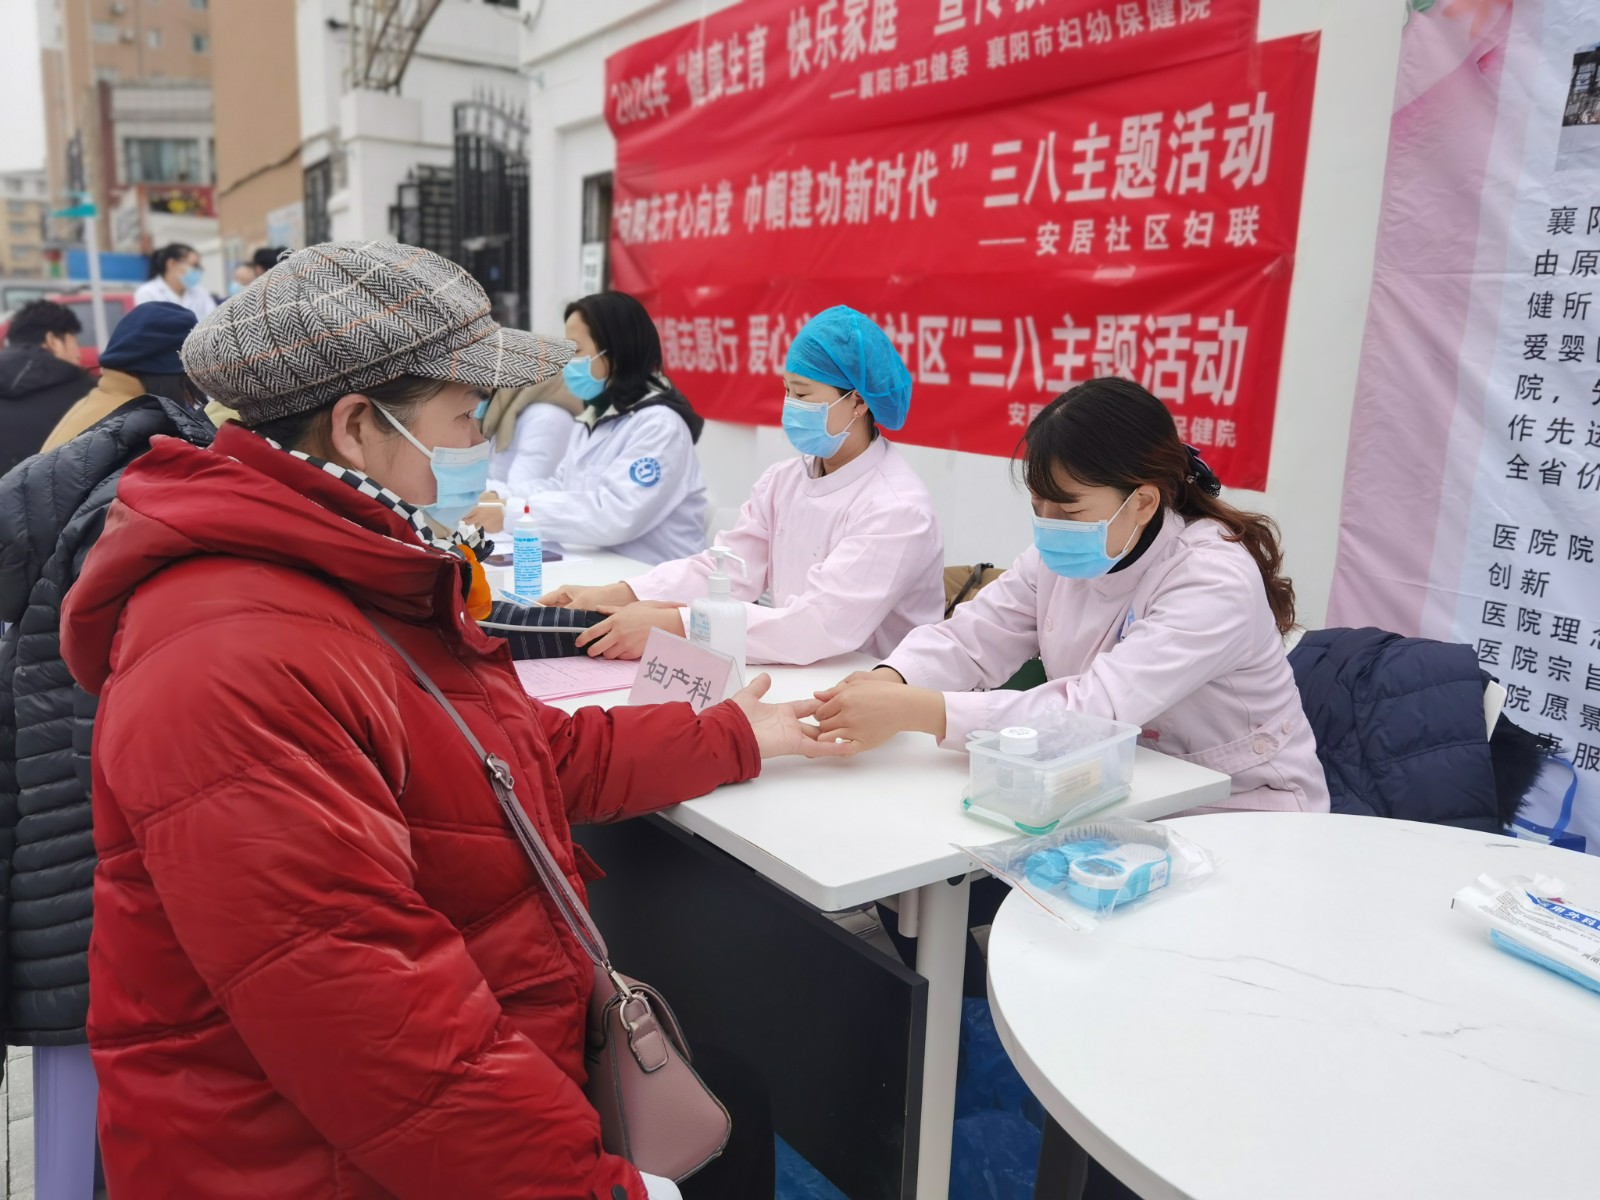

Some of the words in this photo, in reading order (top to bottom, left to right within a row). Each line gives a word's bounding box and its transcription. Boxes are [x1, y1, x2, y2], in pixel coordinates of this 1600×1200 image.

[787, 0, 898, 79] 快乐家庭
[986, 0, 1212, 70] 襄阳市妇幼保健院
[983, 91, 1276, 208] 三八主题活动
[1533, 249, 1600, 278] 由原
[1526, 291, 1592, 320] 健所
[1522, 334, 1600, 363] 爱婴
[1505, 453, 1600, 492] 全省价
[1492, 523, 1595, 564] 医院院
[1488, 562, 1551, 598] 创新
[643, 656, 712, 708] 妇产科
[1493, 677, 1600, 733] 院愿景
